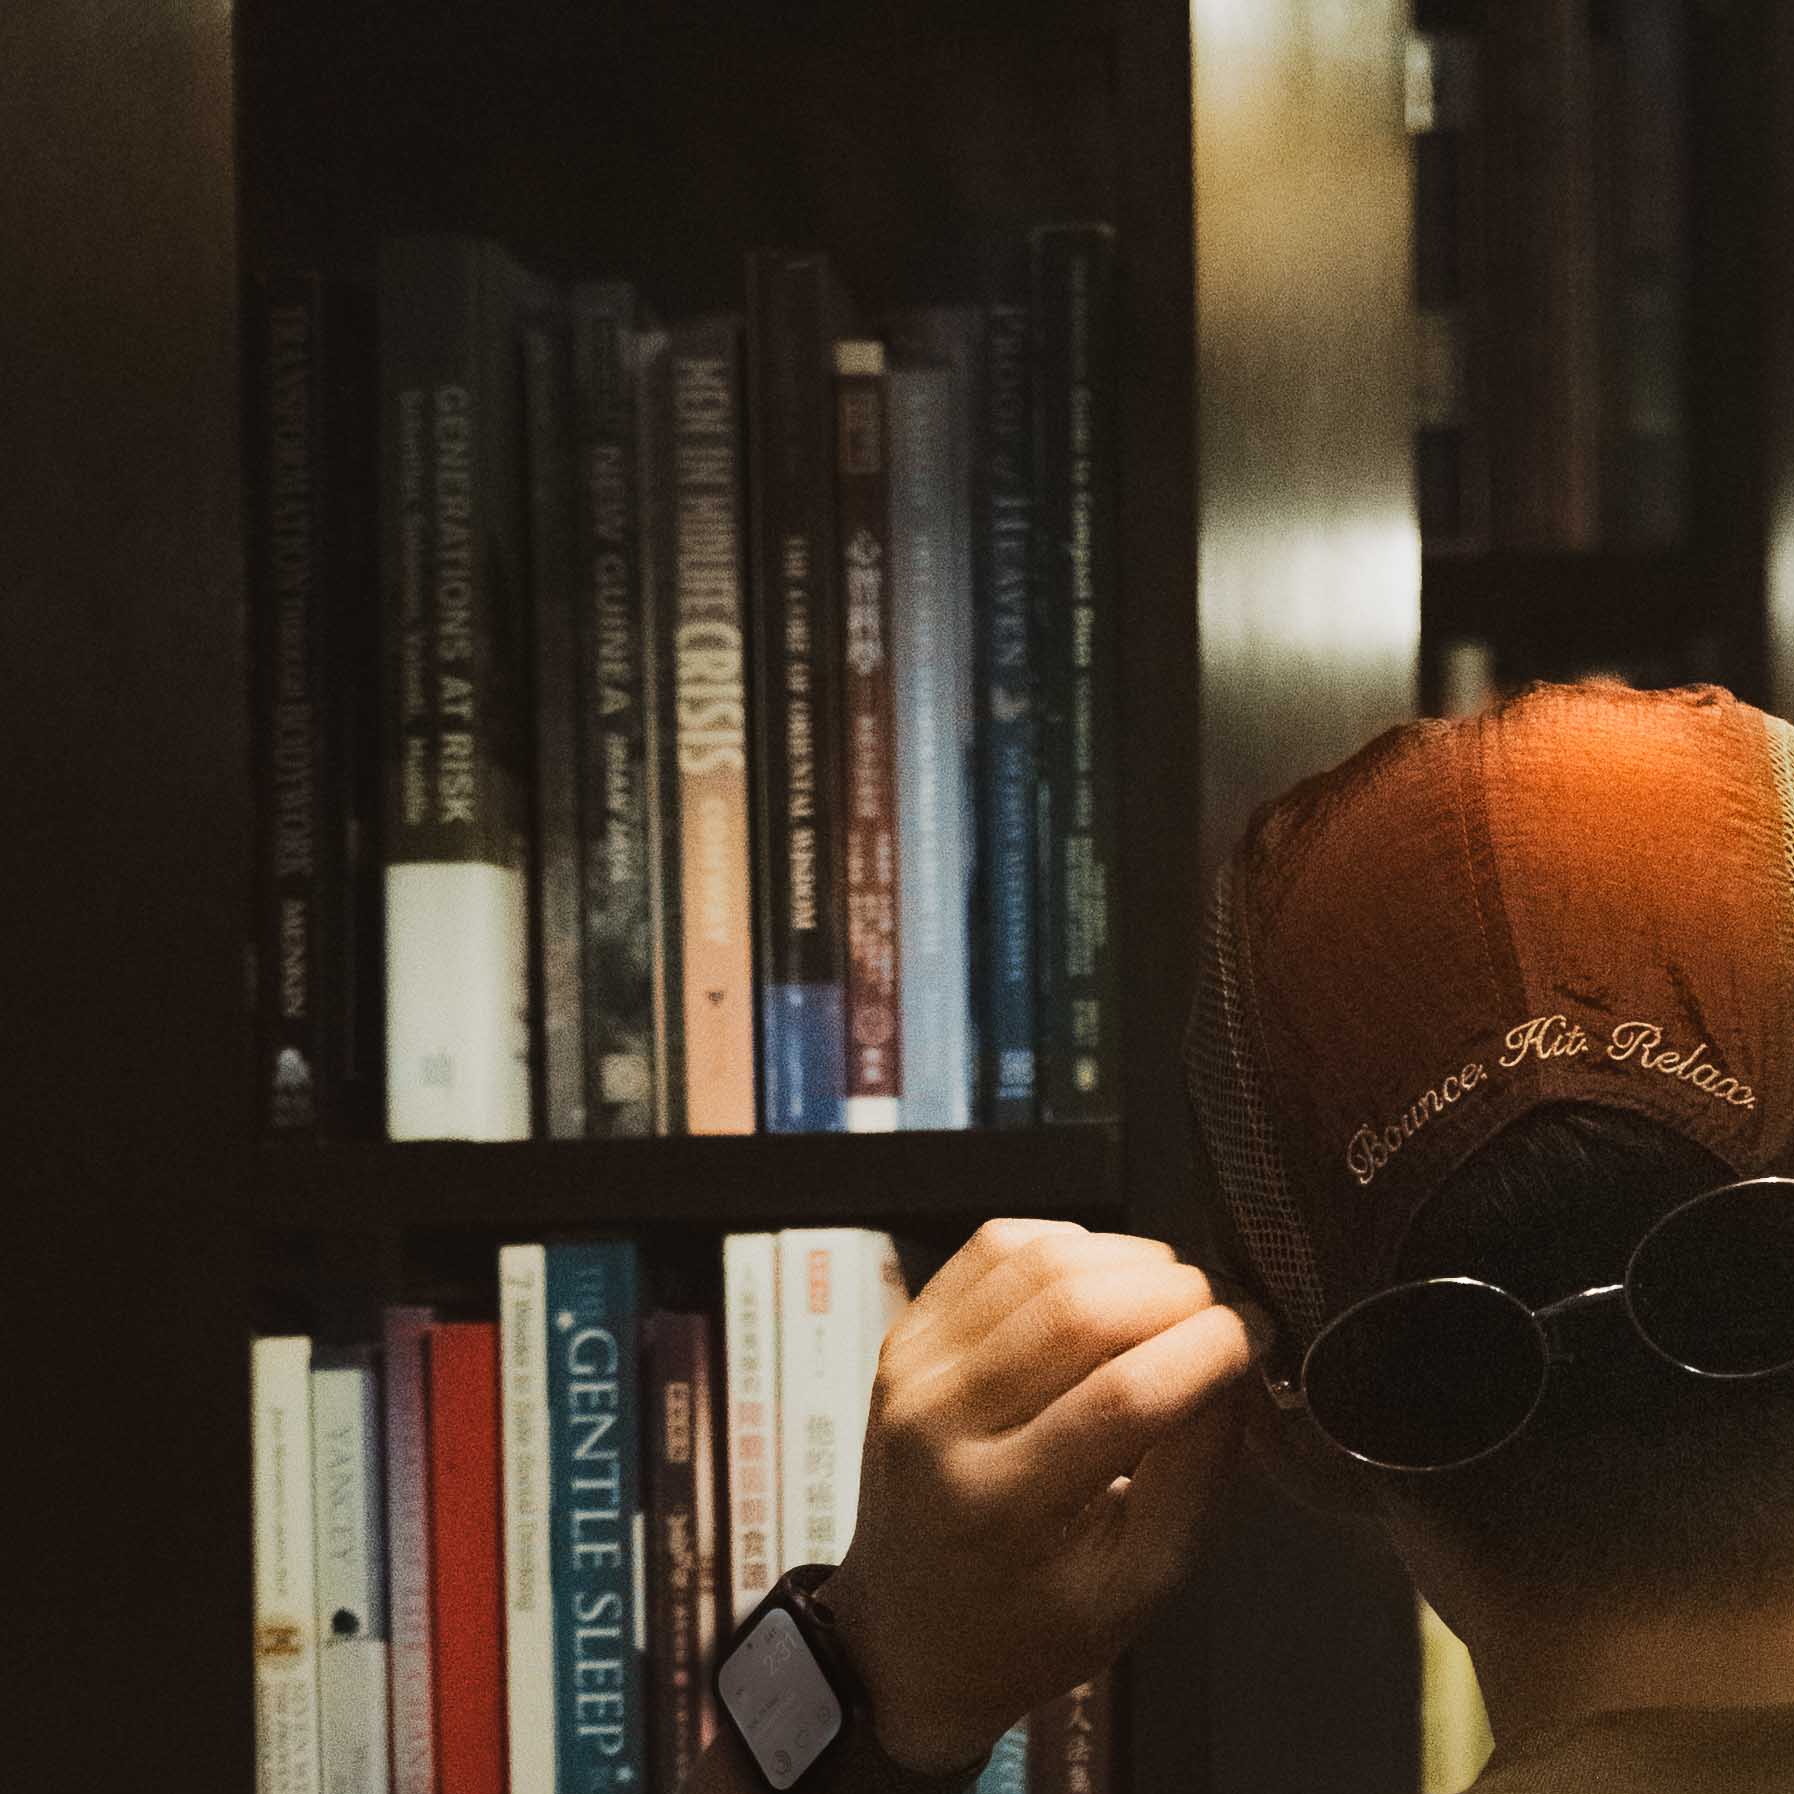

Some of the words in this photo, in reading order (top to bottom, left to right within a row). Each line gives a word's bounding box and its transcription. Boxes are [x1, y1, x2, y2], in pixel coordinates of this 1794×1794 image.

[435, 383, 476, 663] GENERATIONS
[590, 443, 628, 541] NEW
[437, 673, 477, 724] AT
[595, 554, 632, 716] GUINEA
[674, 618, 746, 773] CRISIS
[272, 702, 315, 879] BODYWORK
[437, 729, 477, 825] RISK
[788, 826, 817, 930] WISDOM
[325, 1425, 354, 1566] YANCEY
[565, 1325, 623, 1573] GENTLE
[571, 1590, 627, 1759] SLEEP
